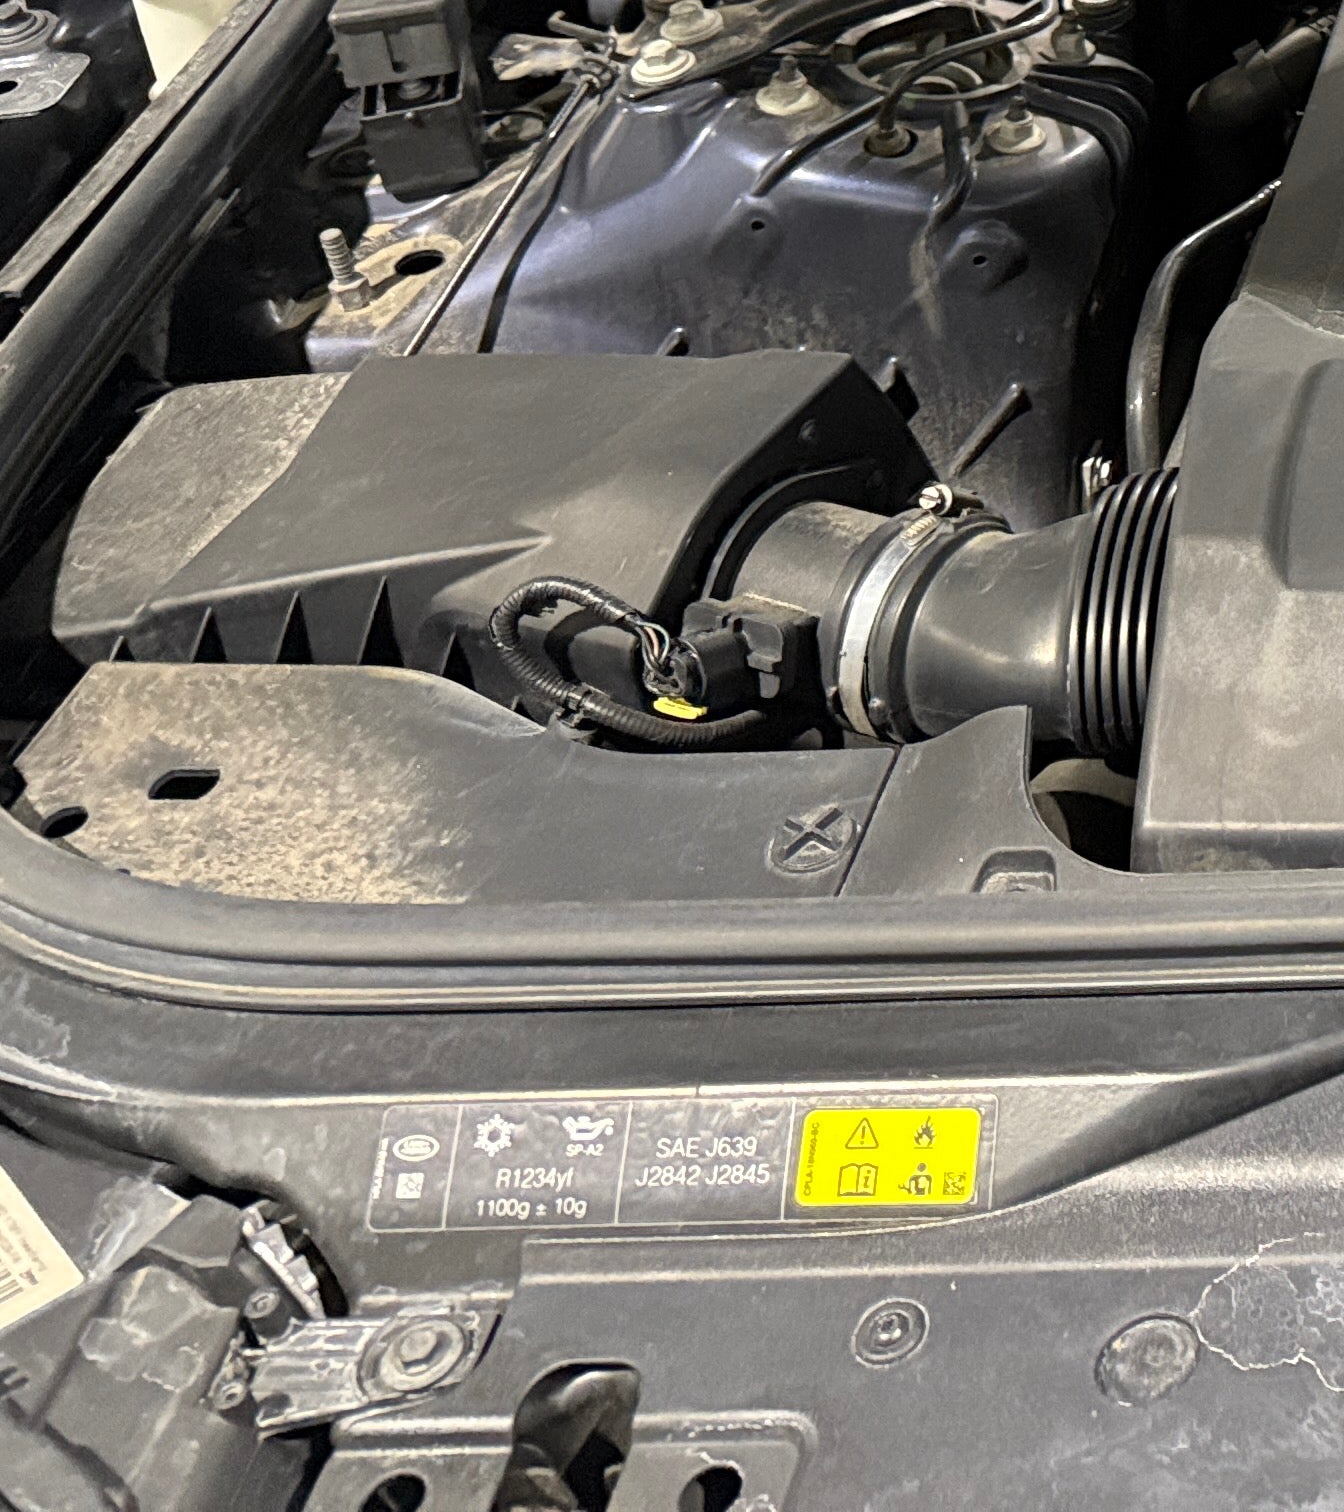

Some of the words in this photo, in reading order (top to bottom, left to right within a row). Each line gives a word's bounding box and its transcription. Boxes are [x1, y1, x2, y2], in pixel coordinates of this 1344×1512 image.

[566, 1143, 605, 1157] SP-A2
[655, 1137, 700, 1159] SAE
[705, 1136, 758, 1158] J639
[495, 1166, 575, 1193] R1234yf
[634, 1164, 701, 1187] J2842
[704, 1163, 771, 1186] J2845
[477, 1198, 531, 1220] 1100g
[555, 1196, 588, 1220] 10g
